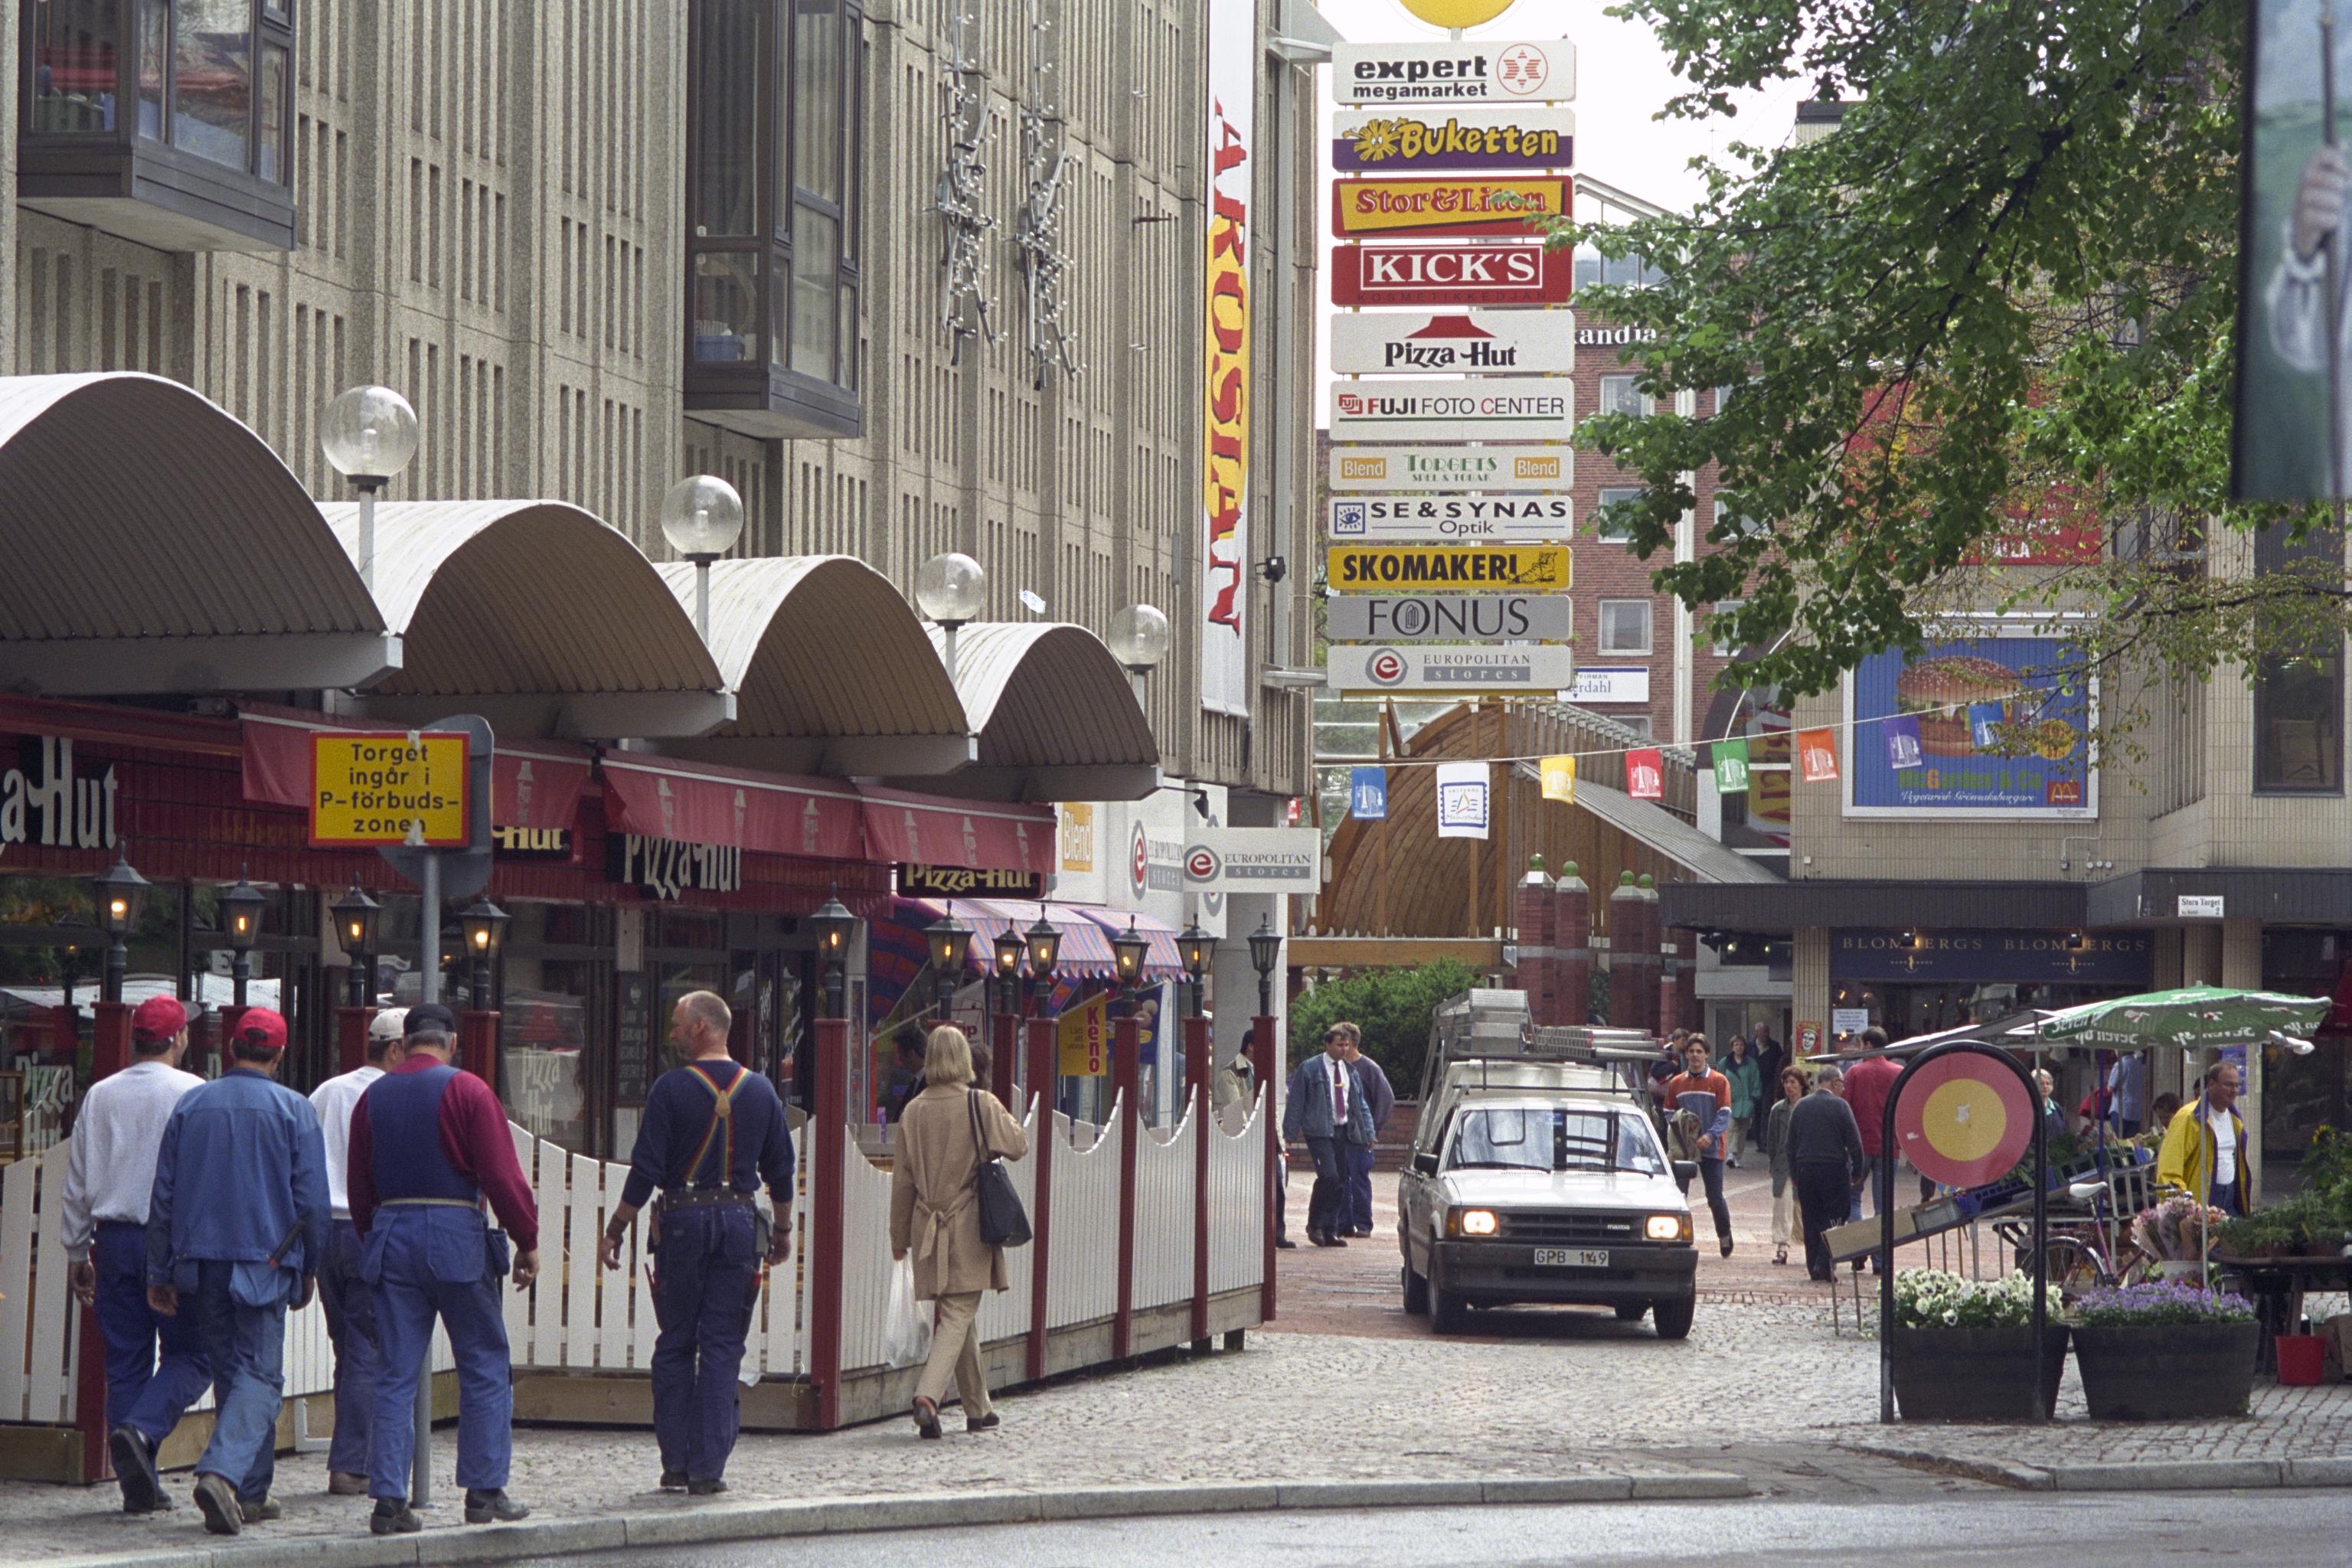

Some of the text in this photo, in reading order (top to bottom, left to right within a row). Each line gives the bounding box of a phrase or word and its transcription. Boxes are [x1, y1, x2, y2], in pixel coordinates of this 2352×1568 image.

[1354, 56, 1487, 82] expert
[1354, 83, 1487, 100] megamarket
[1400, 118, 1559, 158] Buketten
[1370, 253, 1534, 283] KICK'S
[1574, 322, 1657, 344] andia
[1384, 341, 1517, 368] Pizza Hut
[1367, 397, 1416, 415] FUJI
[1422, 397, 1475, 415] FOTO
[1481, 397, 1563, 415] CENTER
[1344, 461, 1383, 476] Blend
[1517, 460, 1557, 475] Blend
[1439, 521, 1494, 537] Optik
[1343, 554, 1517, 581] SKOMAKERI
[1368, 598, 1529, 635] FONUS
[1424, 655, 1530, 665] EUROPOLITAN
[1435, 668, 1518, 678] stores
[351, 743, 429, 765] Torget
[349, 767, 430, 789] ingår i
[27, 736, 118, 849] Hut
[1064, 810, 1092, 862] Blend
[1225, 854, 1311, 864] EUROPOLITAN
[1236, 866, 1300, 876] stores
[1844, 938, 1982, 949] BLOMERGS
[2005, 939, 2145, 950] BLOMERGS
[1088, 1007, 1100, 1073] Keno
[1537, 1250, 1607, 1264] GPB 149
